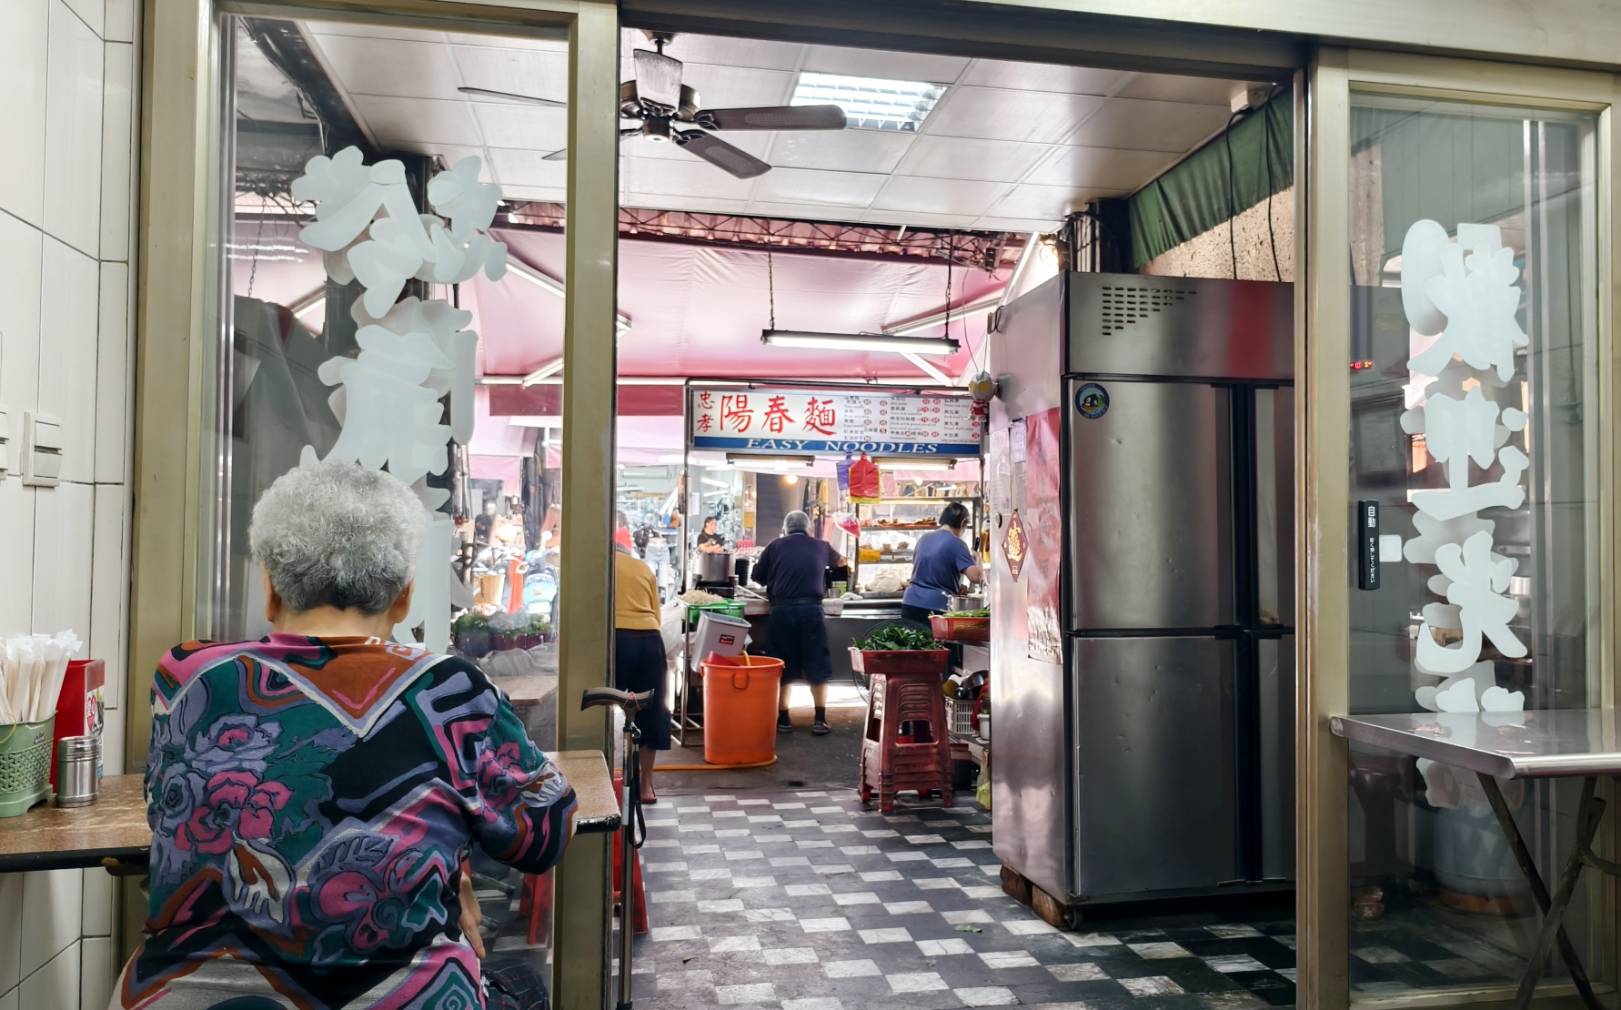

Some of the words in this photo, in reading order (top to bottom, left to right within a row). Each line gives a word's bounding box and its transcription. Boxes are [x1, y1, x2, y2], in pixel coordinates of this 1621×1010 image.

[697, 391, 715, 433] 忠孝
[720, 394, 837, 436] 陽春麵
[747, 438, 809, 451] EASY
[824, 440, 938, 454] NOODLES
